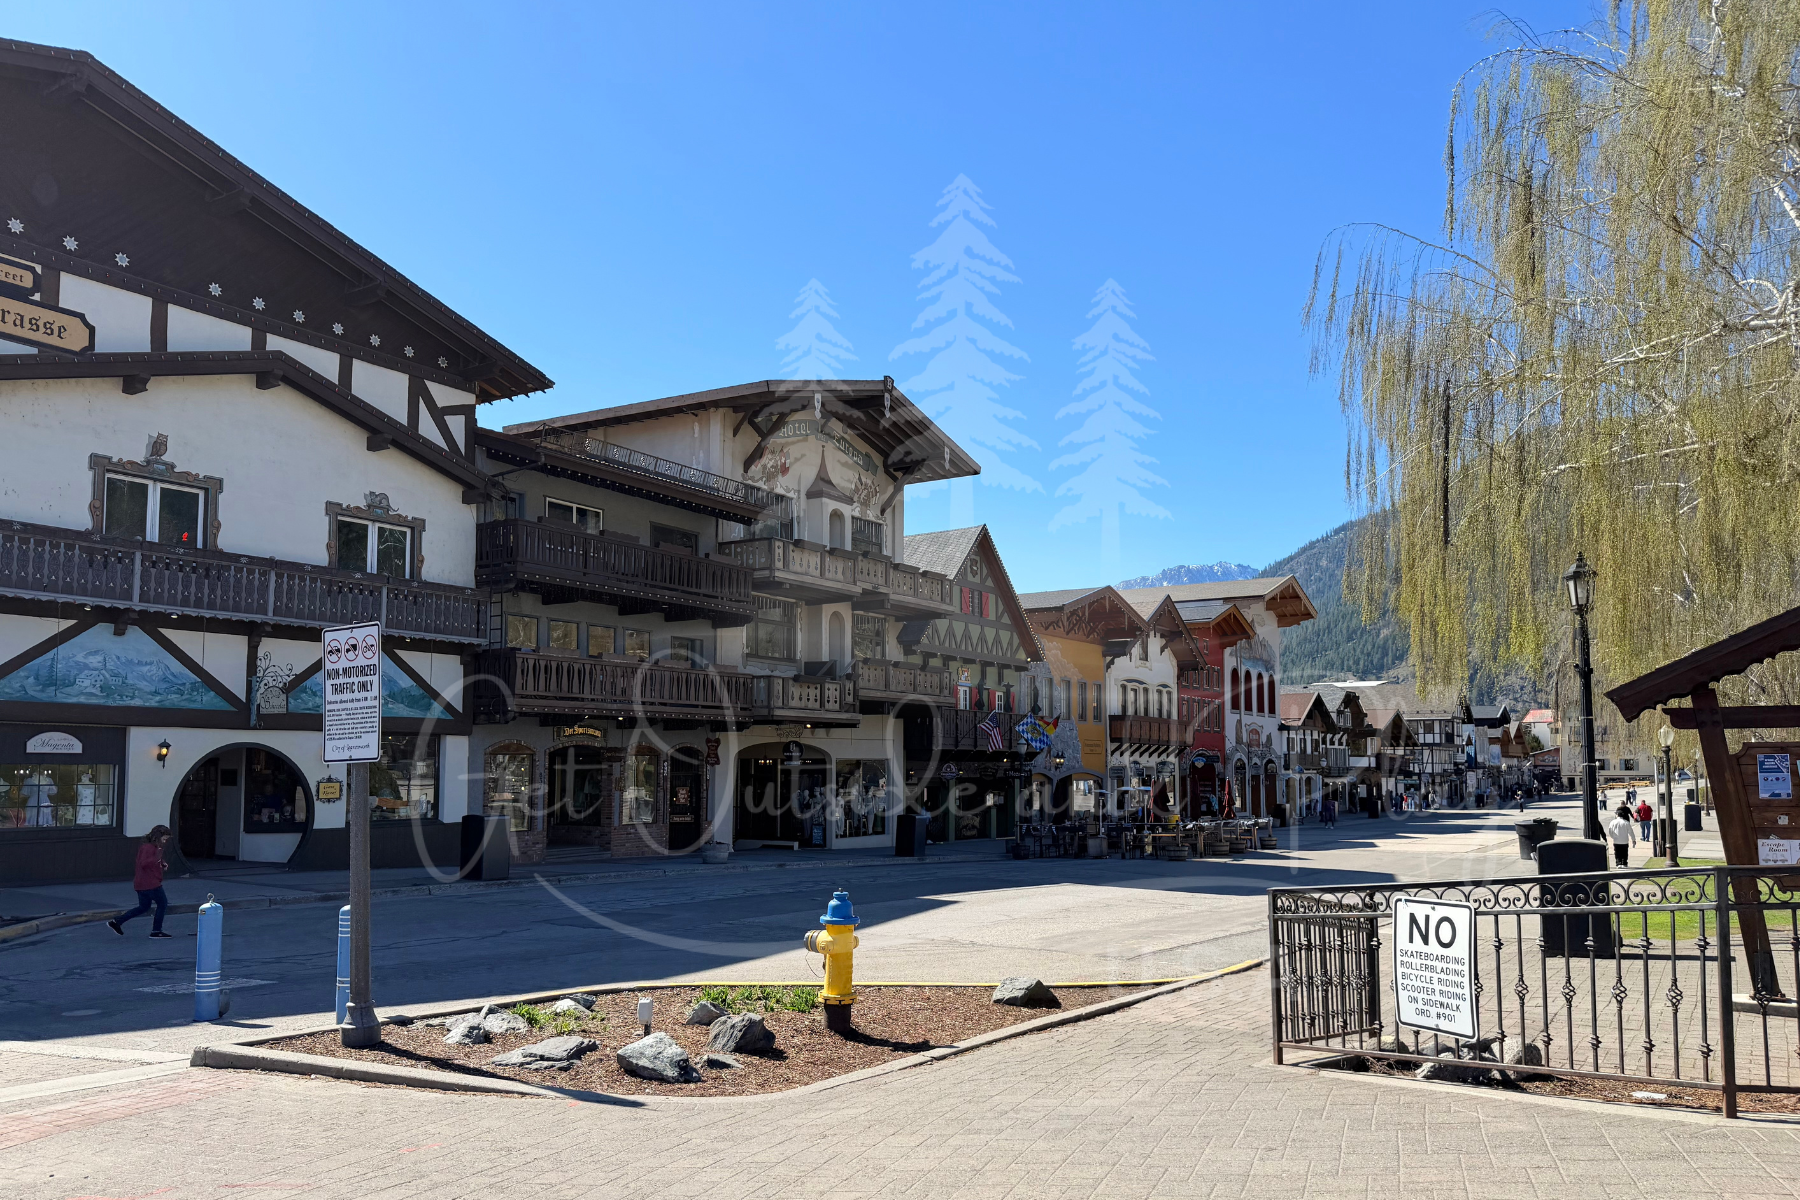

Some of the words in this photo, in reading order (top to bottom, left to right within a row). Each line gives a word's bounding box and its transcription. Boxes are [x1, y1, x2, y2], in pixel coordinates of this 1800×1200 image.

[779, 421, 811, 437] Hotel
[833, 431, 863, 466] Europa
[326, 664, 378, 681] NON-MOTORIZED
[331, 681, 356, 696] TRAFFIC
[357, 680, 374, 694] ONLY
[35, 738, 75, 751] Magenta
[1761, 841, 1785, 849] Escape
[1409, 912, 1457, 949] NO
[1399, 949, 1466, 967] SKATEBOARDING
[1400, 960, 1466, 979] ROLLERBLADING
[1401, 971, 1435, 985] BICYCLE
[1437, 977, 1465, 990] RIDING
[1400, 982, 1436, 997] SCOOTER
[1439, 989, 1467, 1002] RIDING
[1407, 995, 1419, 1004] ON
[1421, 997, 1462, 1013] SIDEWALK
[1415, 1007, 1434, 1019] ORD.
[1436, 1011, 1457, 1024] #901
